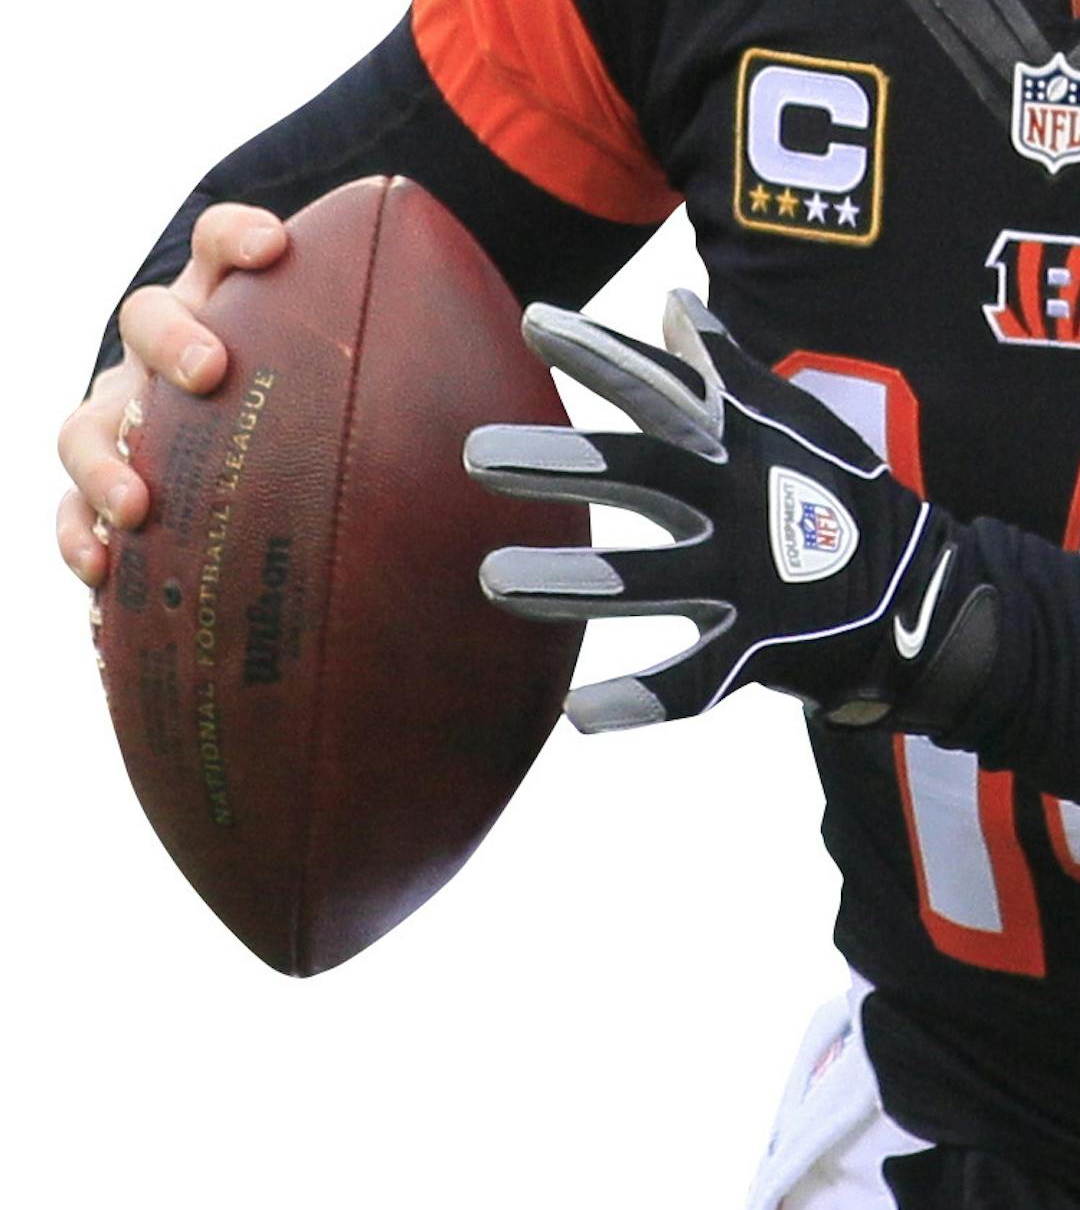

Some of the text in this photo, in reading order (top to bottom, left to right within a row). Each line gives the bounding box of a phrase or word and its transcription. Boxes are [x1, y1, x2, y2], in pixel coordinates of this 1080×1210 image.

[746, 64, 870, 194] C
[783, 482, 802, 567] EQUIPMENT
[815, 508, 838, 548] NFL
[197, 369, 275, 826] NATIONAL FOOTBALL LEAGUE
